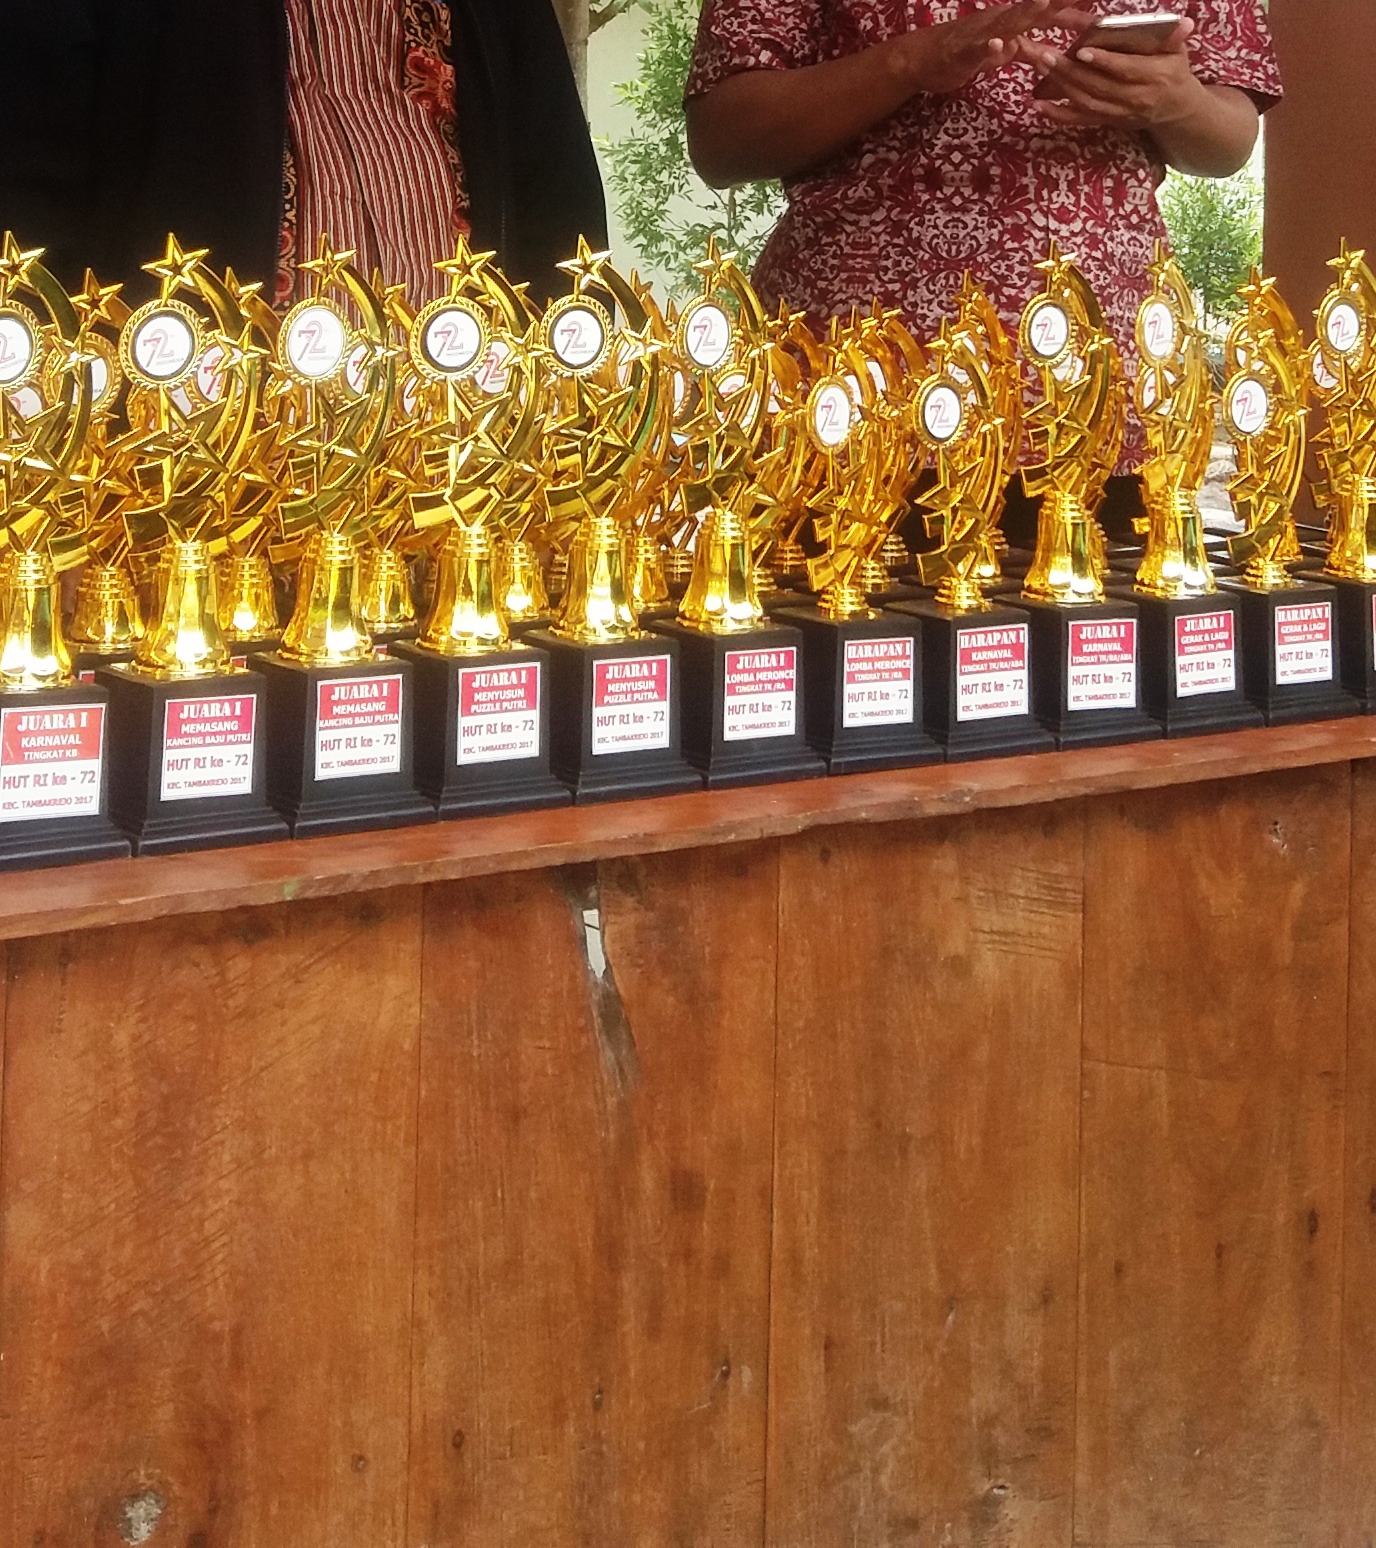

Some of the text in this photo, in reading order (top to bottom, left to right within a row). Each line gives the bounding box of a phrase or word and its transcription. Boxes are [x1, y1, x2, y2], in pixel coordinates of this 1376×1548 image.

[560, 321, 586, 354] 72
[692, 316, 716, 356] 72
[1035, 317, 1056, 345] 72
[298, 321, 327, 362] 72
[434, 322, 464, 358] 72
[143, 329, 174, 367] 72
[960, 631, 1017, 649] HARAPAN
[1080, 626, 1118, 640] JUARA
[972, 649, 1013, 661] KARNAVAL
[1082, 643, 1122, 652] KARNAVAL
[736, 655, 777, 670] JUARA
[472, 672, 518, 688] JUARA
[606, 665, 649, 680] JUARA
[727, 670, 794, 684] LOMBA MERONCE
[331, 685, 378, 701] JUARA
[607, 681, 655, 692] MENYUSUN
[736, 684, 762, 693] TINGKAT
[961, 684, 979, 695] HUT
[982, 683, 991, 693] RI
[994, 681, 1004, 691] ke
[1012, 680, 1023, 690] 72
[474, 688, 524, 702] MENYUSUN
[604, 691, 658, 704] PUZZLE PUTRA
[179, 701, 230, 719] JUARA
[332, 702, 386, 716] MEMASANG
[470, 700, 526, 714] PUZZLE PUTRI
[728, 704, 746, 715] HUT
[749, 703, 759, 713] RI
[762, 702, 773, 712] ke
[781, 700, 792, 710] 72
[17, 713, 76, 732] JUARA
[319, 714, 399, 728] KANCING BAJU PUTRA
[596, 716, 616, 726] HUT
[619, 715, 630, 724] RI
[633, 713, 644, 723] ke
[653, 711, 665, 721] 72
[181, 721, 238, 734] MEMASANG
[462, 725, 483, 737] HUT
[486, 724, 498, 734] RI
[500, 722, 512, 733] ke
[522, 720, 534, 731] 72
[21, 733, 82, 748] KARNAVAL
[166, 733, 251, 748] KANCING BAJU PUTRI
[320, 738, 342, 751] HUT
[346, 738, 358, 748] RI
[361, 736, 373, 747] ke
[383, 734, 396, 745] 72
[24, 749, 78, 760] TINGKAT KB
[166, 757, 191, 771] HUT
[194, 757, 206, 769] RI
[210, 756, 224, 767] ke
[234, 754, 248, 766] 72
[2, 775, 30, 789] HUT
[33, 774, 47, 787] RI
[52, 773, 67, 785] ke
[80, 770, 96, 784] 72
[22, 798, 72, 808] TAMBAKREJO
[75, 796, 93, 805] 2017
